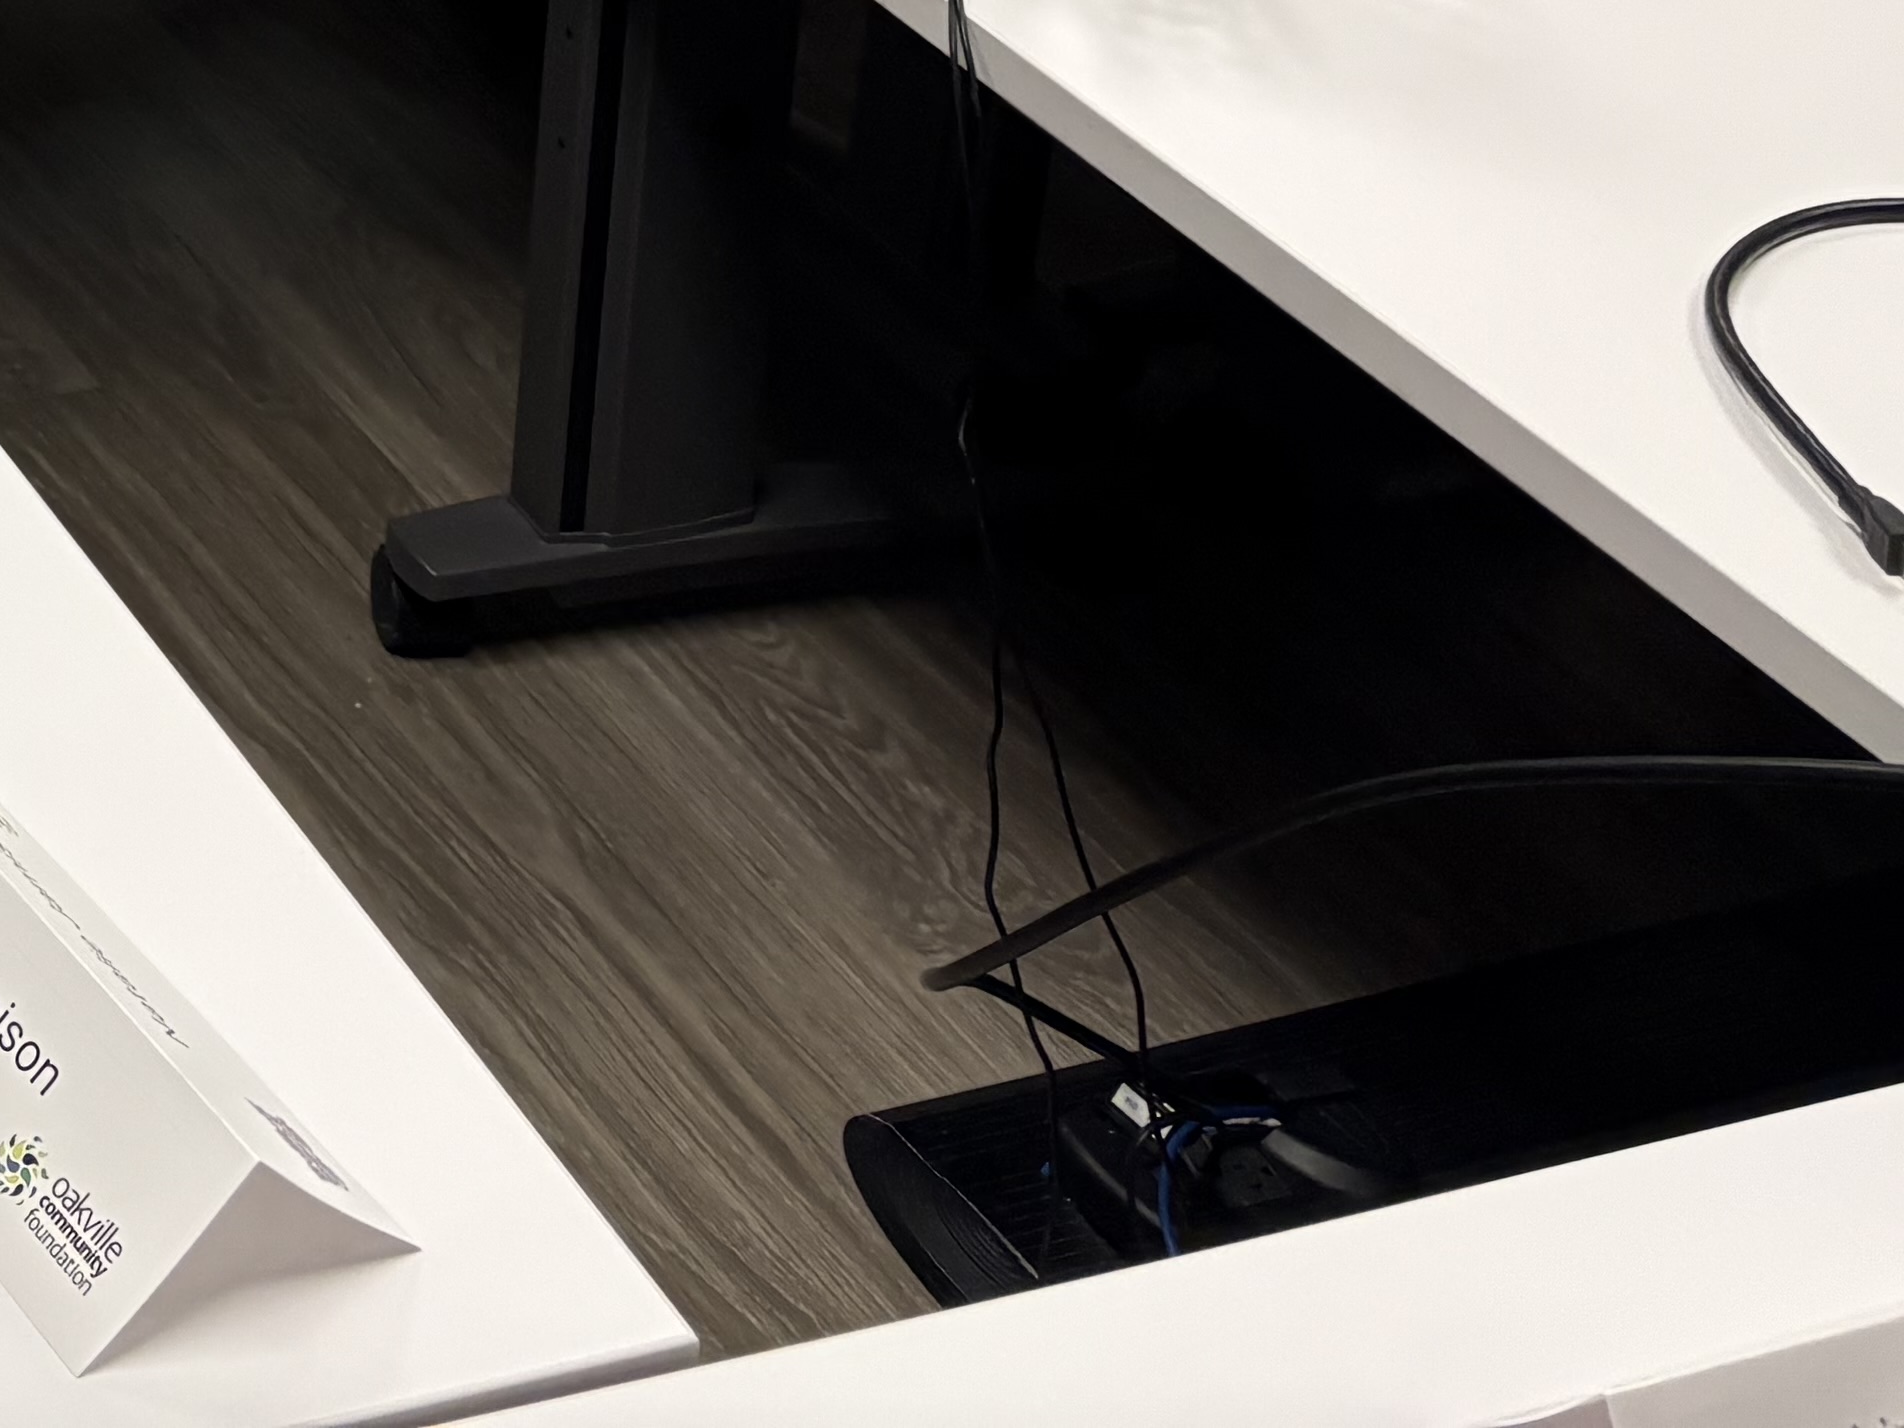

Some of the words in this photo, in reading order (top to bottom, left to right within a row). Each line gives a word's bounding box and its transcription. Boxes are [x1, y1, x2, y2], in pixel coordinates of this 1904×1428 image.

[24, 1208, 92, 1296] foundation
[39, 1195, 108, 1278] community
[52, 1177, 123, 1264] oakville
